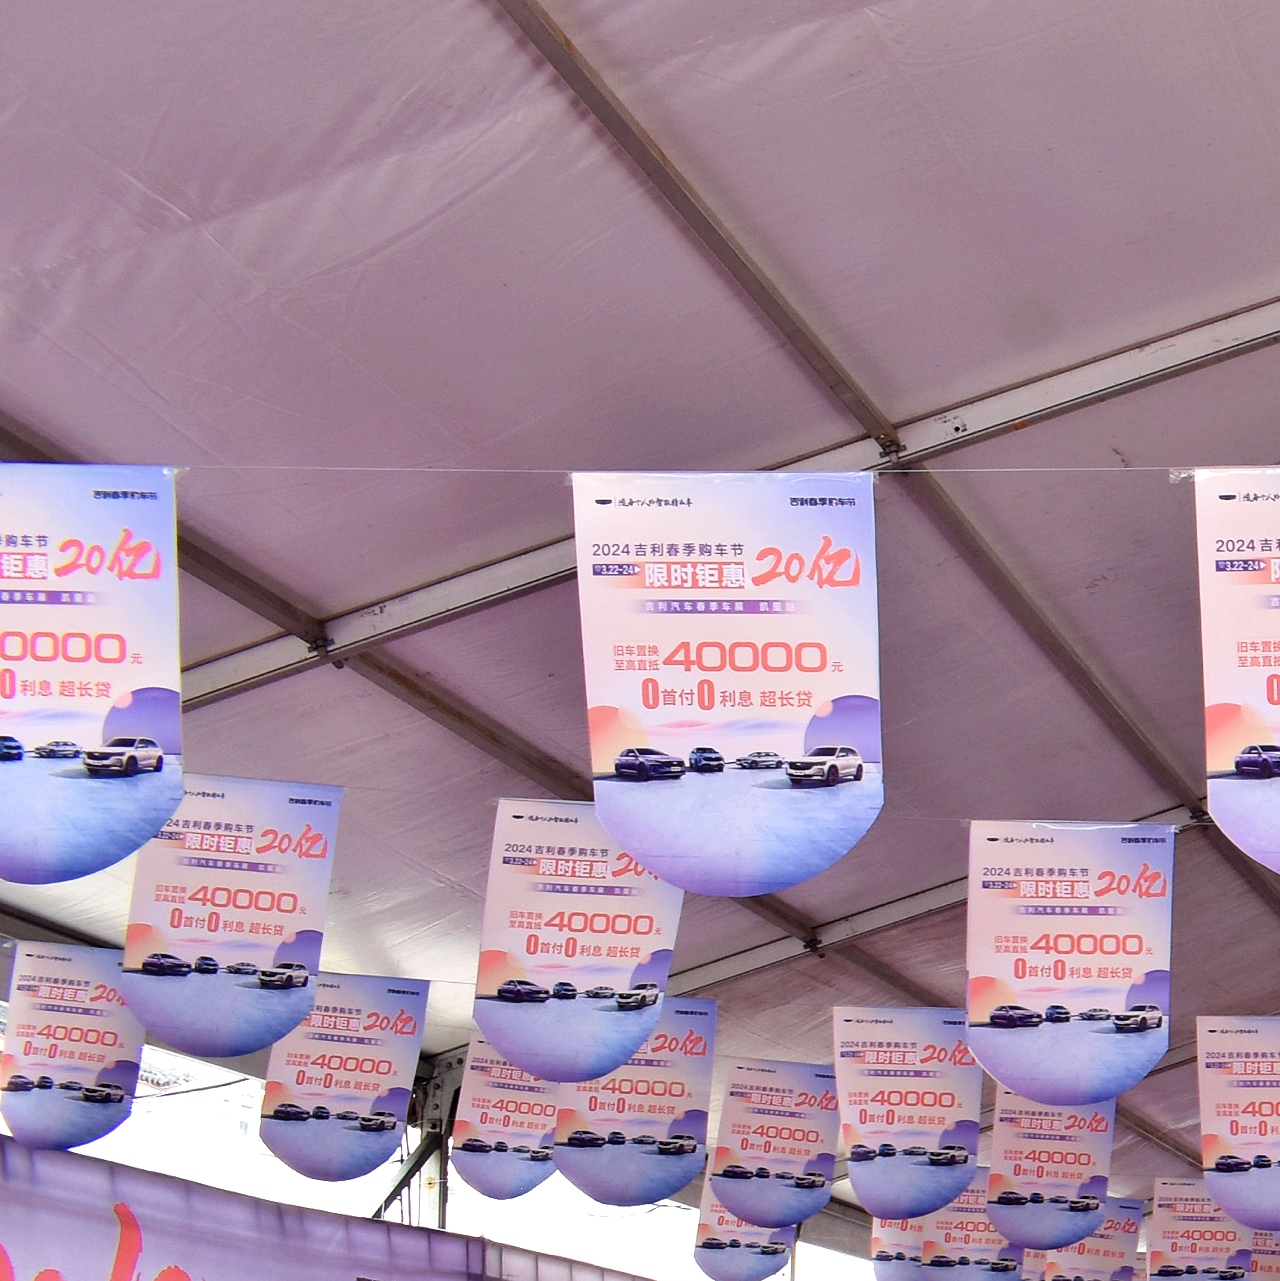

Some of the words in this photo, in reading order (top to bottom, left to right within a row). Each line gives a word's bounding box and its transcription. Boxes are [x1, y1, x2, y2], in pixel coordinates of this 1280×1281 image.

[53, 527, 161, 581] 20亿
[752, 535, 860, 589] 20亿
[645, 563, 747, 588] 限时钜惠
[255, 824, 328, 859] 20亿
[1093, 863, 1168, 899] 20亿
